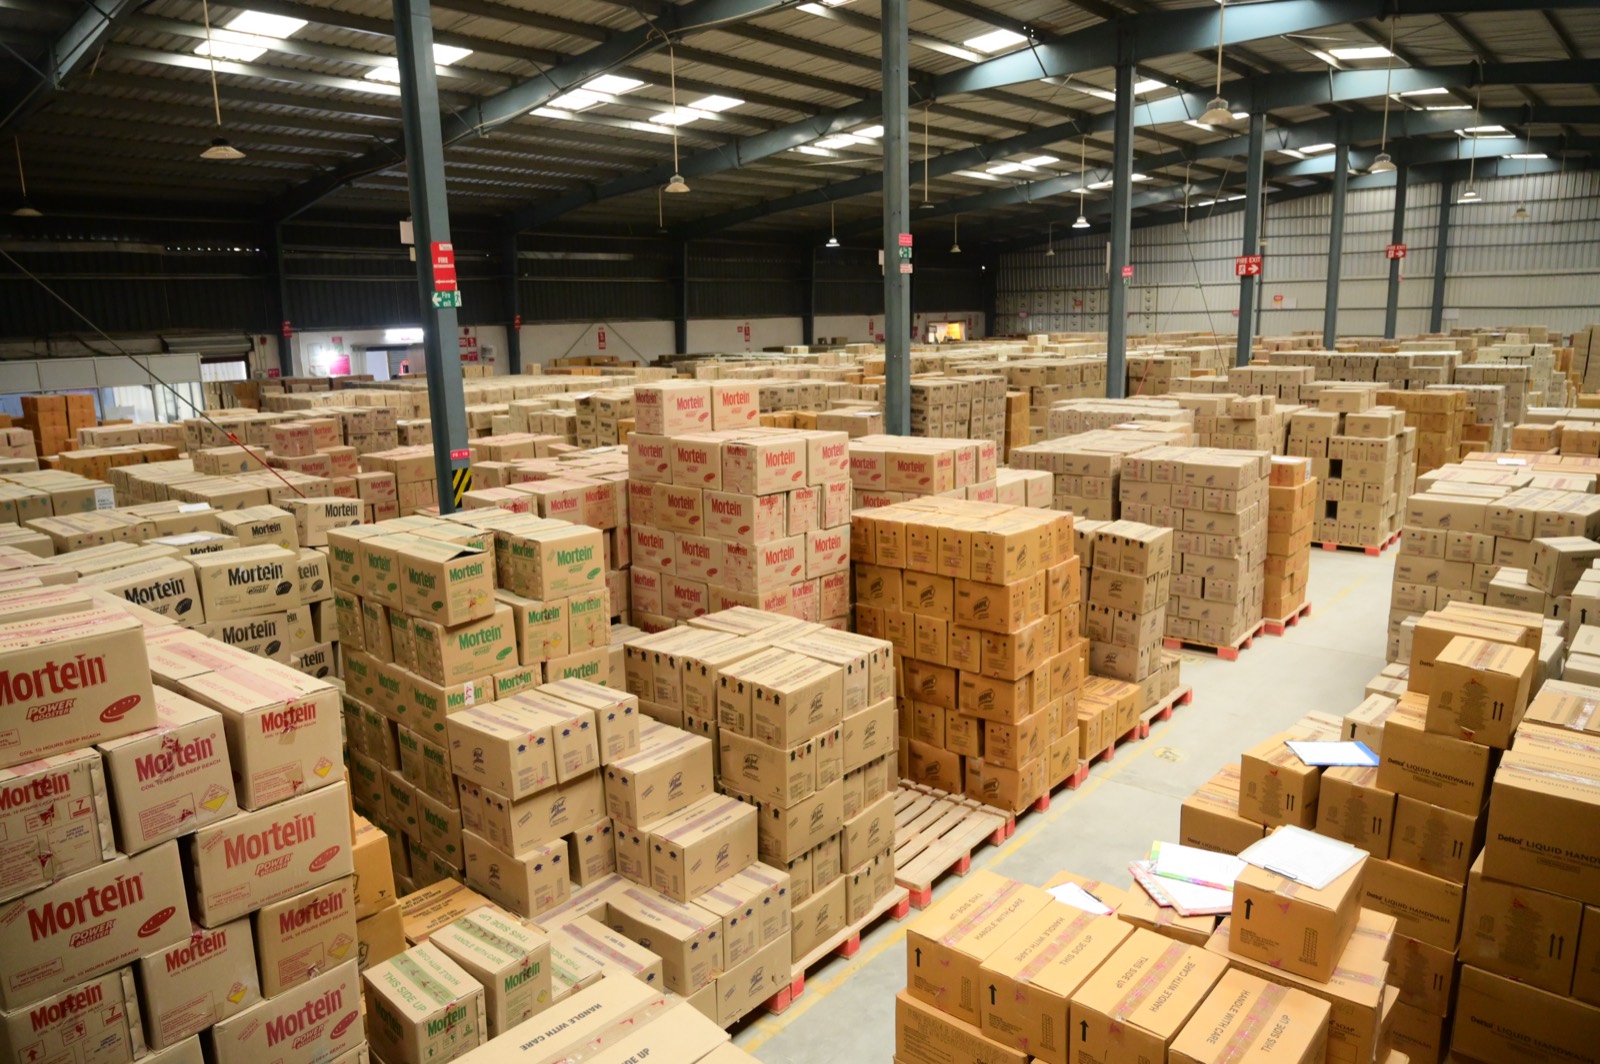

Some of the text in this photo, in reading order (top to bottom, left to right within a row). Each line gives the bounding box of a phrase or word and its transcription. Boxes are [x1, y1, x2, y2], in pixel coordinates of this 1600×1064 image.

[677, 396, 704, 410] Mortein
[722, 391, 750, 405] Mortein
[638, 445, 663, 459] Mortein
[678, 448, 707, 464] Mortein
[765, 449, 796, 467] Mortein
[822, 442, 846, 460] Mortein
[850, 457, 877, 469] Mortein
[897, 460, 926, 473] Mortein
[334, 485, 351, 496] ortein
[371, 480, 392, 491] Mortein
[325, 504, 357, 518] Mortein
[551, 498, 578, 511] Mortein
[668, 495, 695, 510] Mortein
[711, 499, 742, 517] Mortein
[252, 522, 281, 536] Mortein
[637, 531, 664, 547] Mortein
[681, 541, 710, 559] Mortein
[814, 536, 842, 553] Mortein
[557, 547, 593, 566] Mortein
[765, 546, 795, 567] Mortein
[228, 562, 283, 586] Mortein
[409, 568, 436, 589] Mortein
[449, 561, 483, 581] Mortein
[125, 578, 185, 605] Mortein
[674, 586, 701, 602] Mortein
[572, 596, 600, 613] Mortein
[529, 607, 560, 624] Mortein
[223, 621, 276, 644] Mortein
[459, 626, 502, 649] Mortein
[447, 687, 482, 706] Morin
[26, 698, 76, 719] POWER
[32, 708, 70, 722] BOOSTER
[261, 702, 316, 734] Mortein
[135, 735, 213, 783] Mortein
[140, 784, 155, 792] COIL
[185, 766, 201, 775] DEEP
[201, 758, 221, 769] REACH
[1388, 757, 1475, 788] Dettol LIQUID HANDWASH
[0, 773, 70, 811] Mortein
[76, 800, 84, 810] 7
[224, 814, 316, 869] Mortein
[1498, 833, 1522, 846] Dettol
[1526, 840, 1562, 855] LIQUID
[256, 853, 293, 873] POWER
[28, 874, 144, 942] Mortein
[279, 892, 343, 935] Mortein
[333, 910, 349, 921] REACH
[949, 891, 984, 921] THIS SIDE UP
[1384, 897, 1408, 910] LIQUID
[1409, 906, 1450, 923] HANDWASH
[975, 897, 1025, 941] HANDLE WITH CARE
[69, 919, 116, 945] POWER
[75, 930, 111, 947] BOOSTER
[1016, 917, 1066, 962] HANDLE WITH CARE
[165, 930, 226, 973] Mortein
[1059, 935, 1094, 967] THIS SIDE UP
[63, 975, 76, 983] COIL
[85, 963, 105, 975] HOURS
[106, 957, 120, 966] DEEP
[121, 948, 139, 960] REACH
[1116, 956, 1149, 989] THIS SIDE UP
[505, 961, 540, 993] Mortein
[1151, 961, 1196, 1013] HANDLE WITH CARE
[384, 972, 428, 1013] THIS SIDE UP
[30, 983, 103, 1032] Mortein
[109, 1006, 116, 1016] 7
[1208, 989, 1250, 1044] HANDLE WITH CARE
[266, 991, 342, 1047] Mortein
[428, 1005, 467, 1037] Mortein
[519, 1003, 603, 1051] HANDLE WITH CARE
[292, 1024, 325, 1049] POWER
[1261, 1014, 1292, 1053] THIS SIDE UP
[330, 1042, 346, 1055] REACH
[636, 1047, 650, 1062] UP
[1497, 1025, 1531, 1042] LIQUID
[1534, 1039, 1595, 1064] HANDWASH
